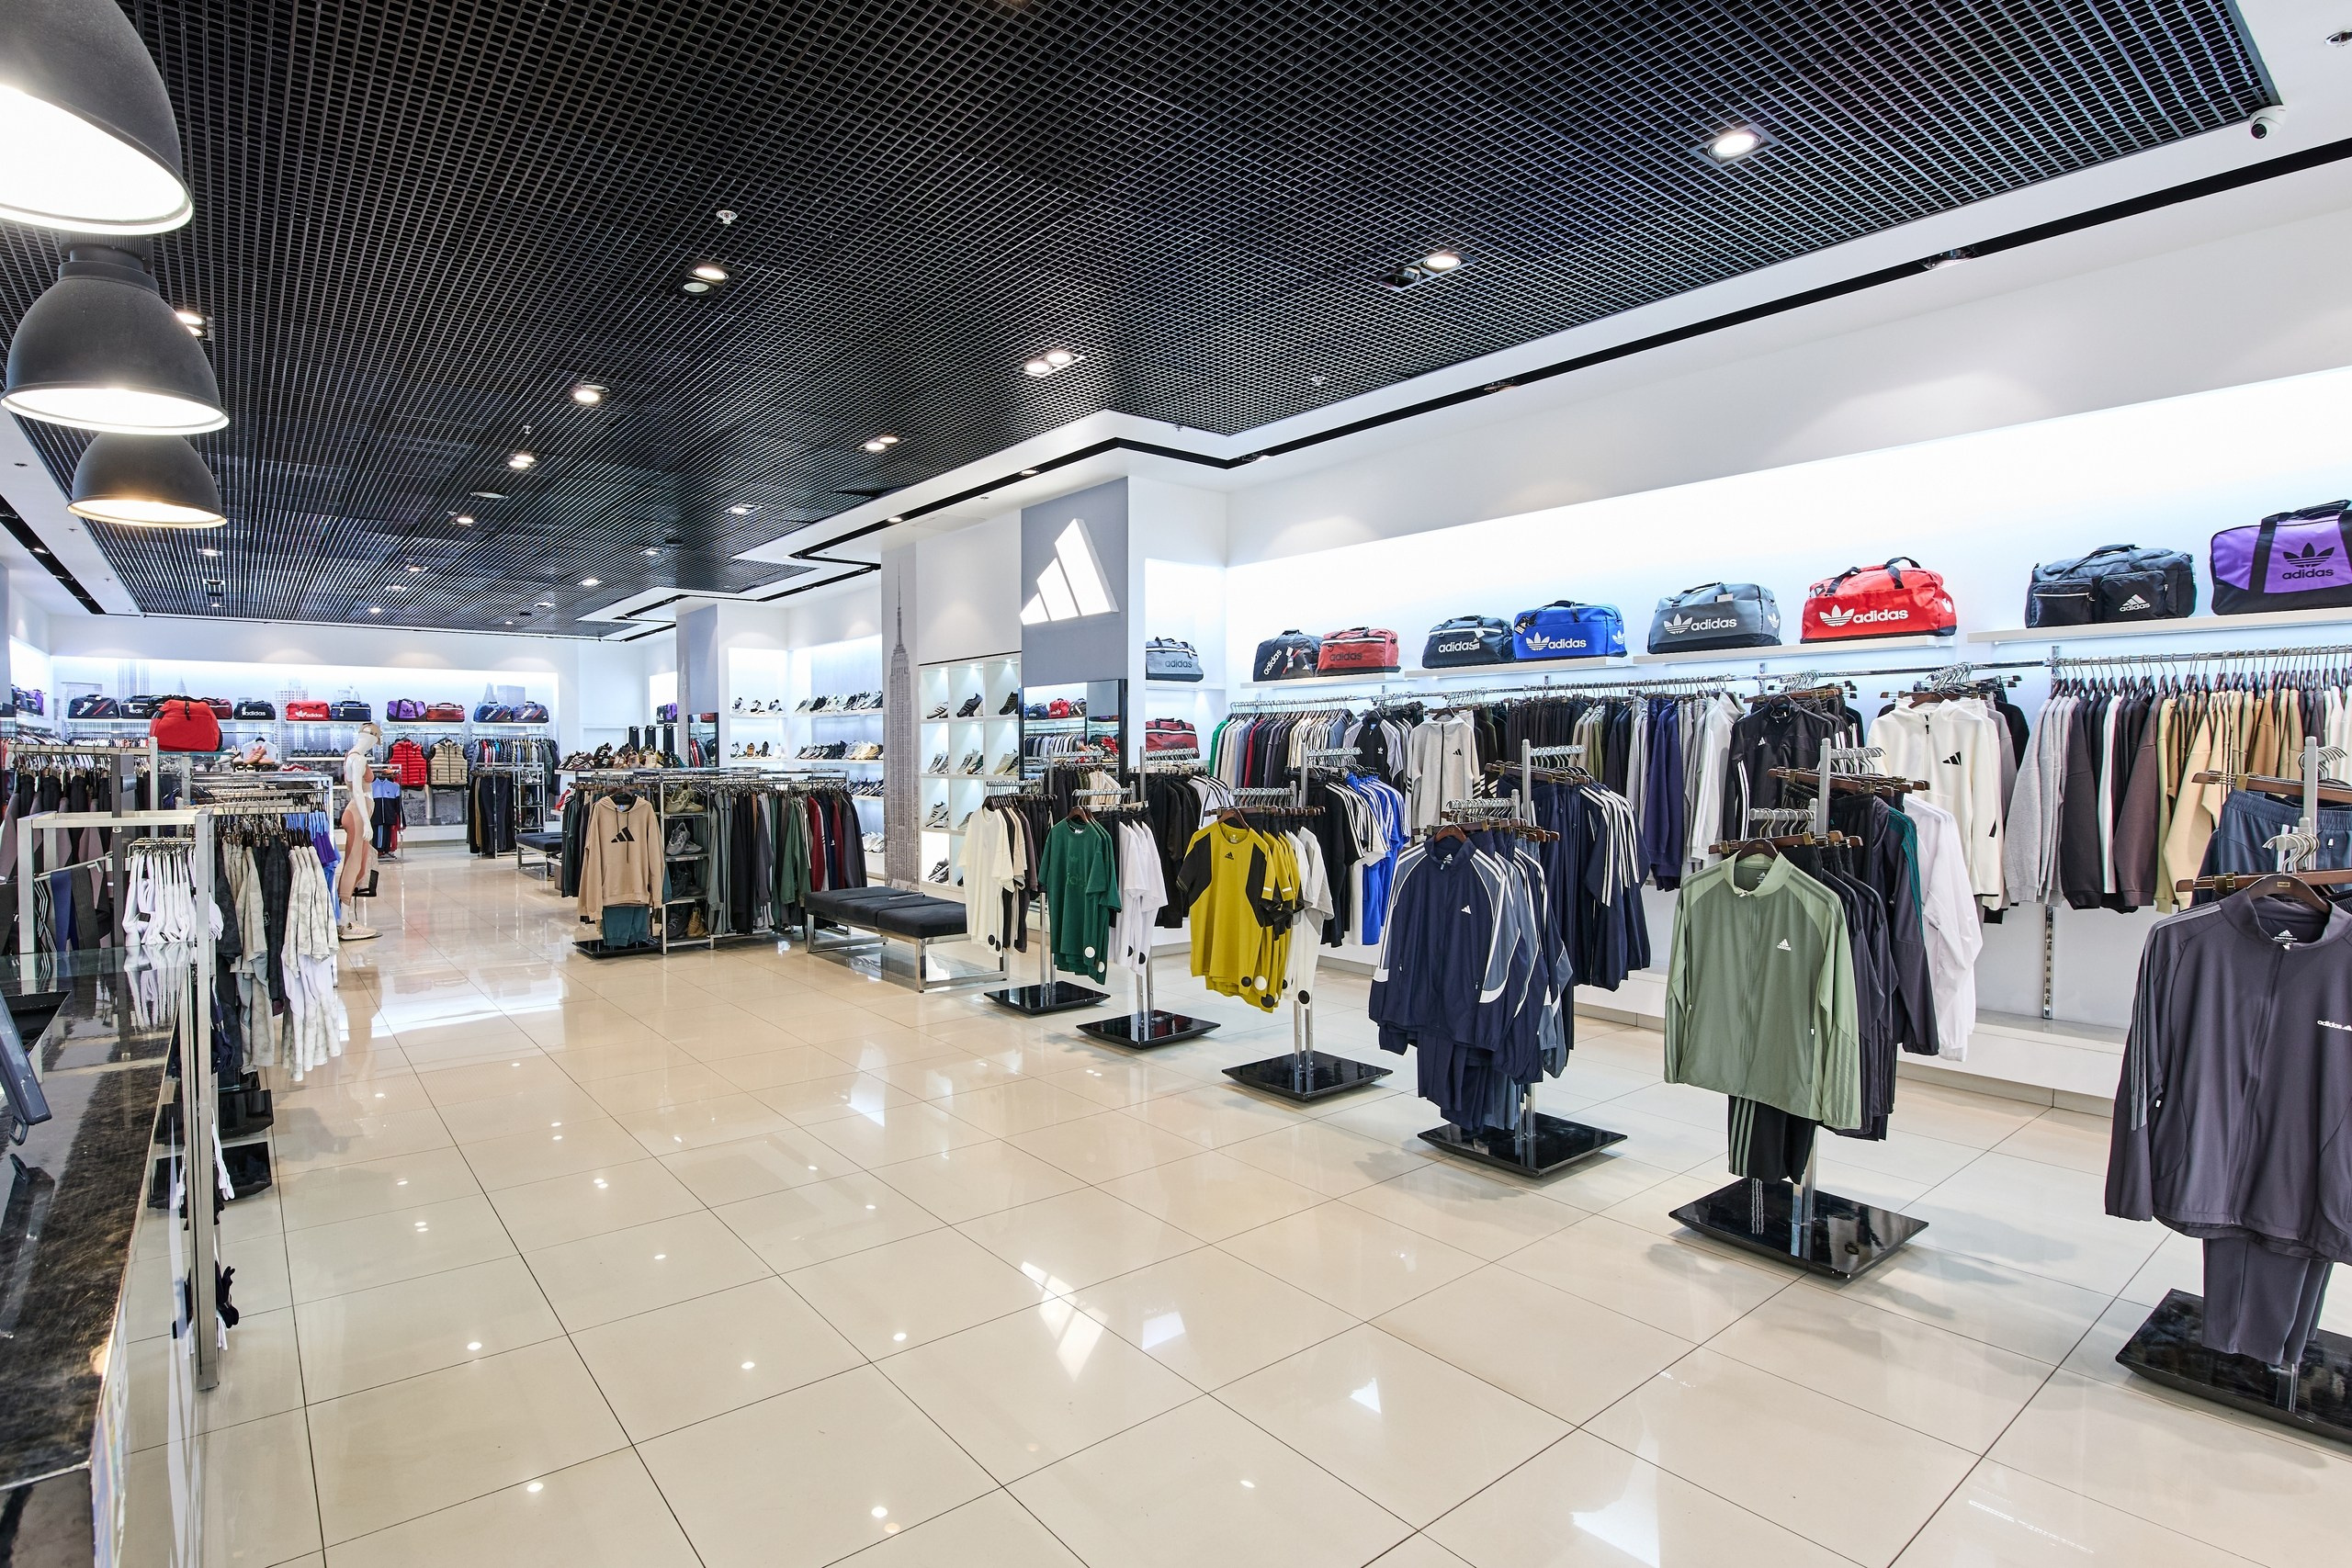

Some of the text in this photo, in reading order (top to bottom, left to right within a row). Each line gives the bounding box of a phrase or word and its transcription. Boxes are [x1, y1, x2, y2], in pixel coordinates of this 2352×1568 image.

[2282, 568, 2335, 581] adidas
[2120, 602, 2150, 612] adidas
[1852, 608, 1909, 625] adidas
[1690, 617, 1738, 632] adidas
[1438, 641, 1475, 654] adidas
[1548, 637, 1588, 650] adidas
[1263, 649, 1283, 676] adidas
[1329, 651, 1363, 662] adidas
[1165, 659, 1193, 669] adidas
[2317, 1020, 2343, 1030] adidas
